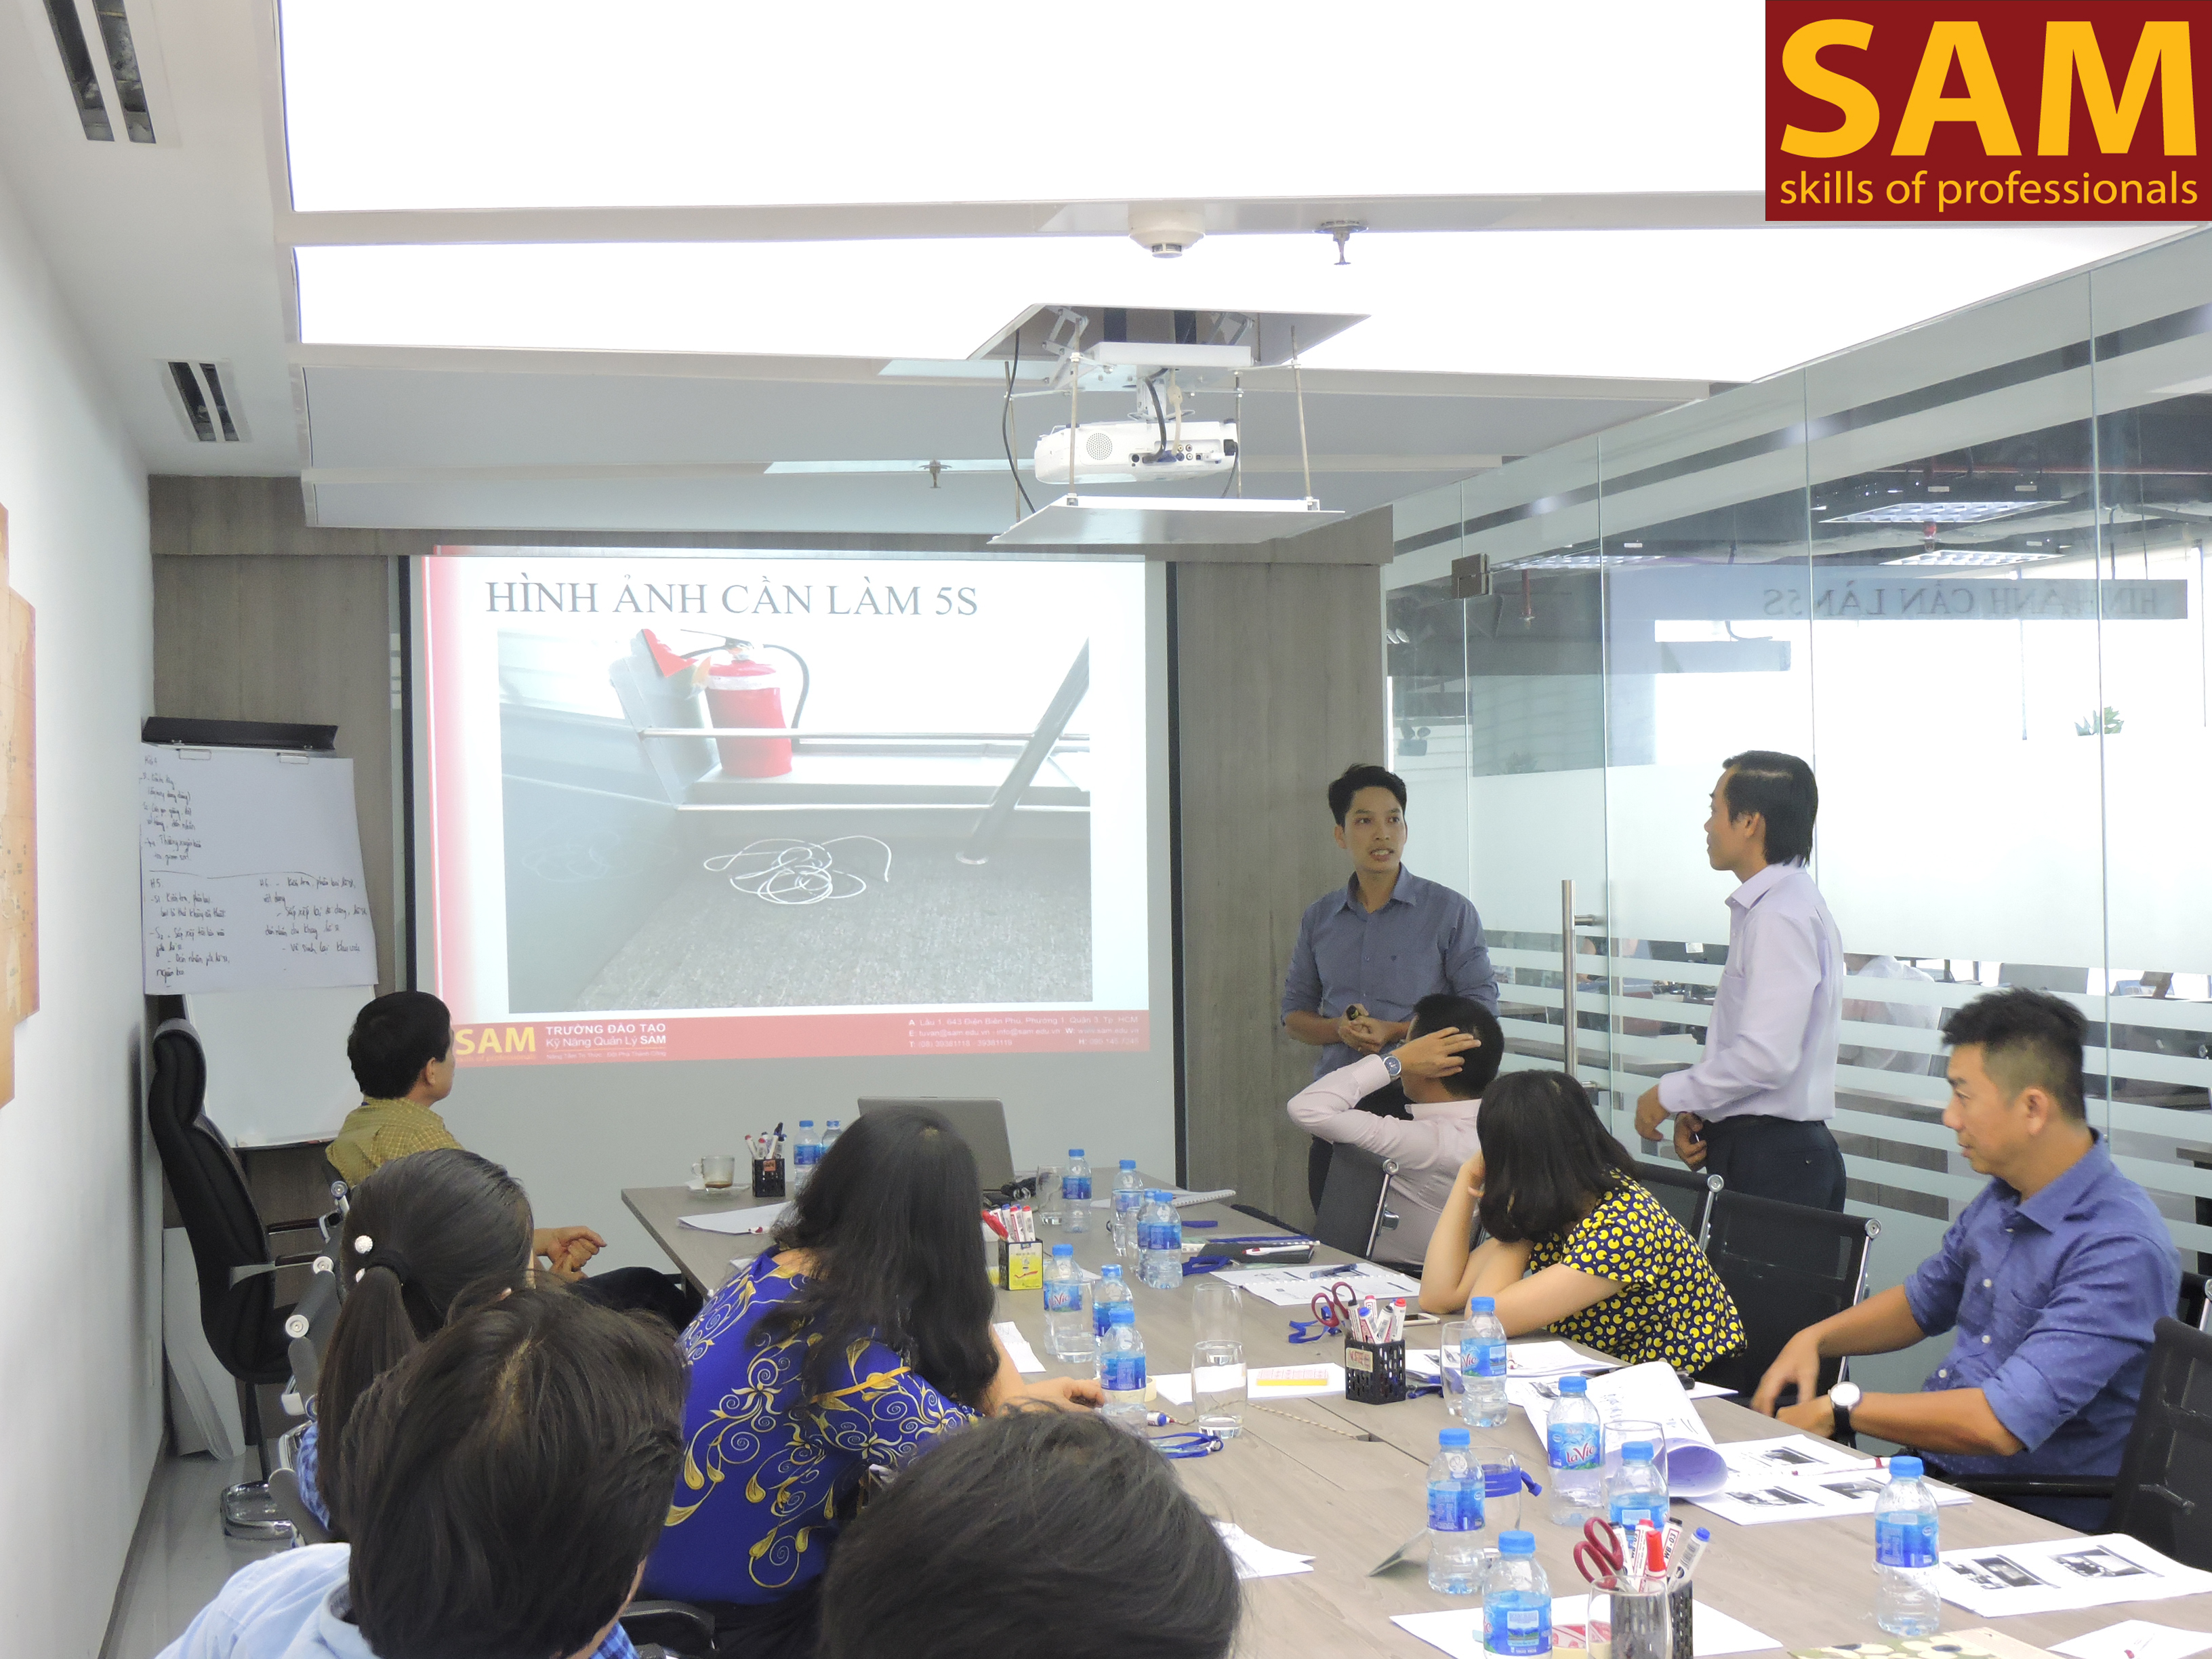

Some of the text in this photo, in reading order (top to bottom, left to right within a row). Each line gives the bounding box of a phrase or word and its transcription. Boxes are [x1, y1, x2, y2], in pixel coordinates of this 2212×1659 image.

[485, 572, 978, 616] HÌNH ẢNH CẦN LÀM 5S
[546, 1023, 604, 1036] TRƯỜNG
[640, 1023, 666, 1034] TẠO
[455, 1027, 535, 1055] SAM
[546, 1035, 666, 1049] Kỹ Năng Quản Lý SAM
